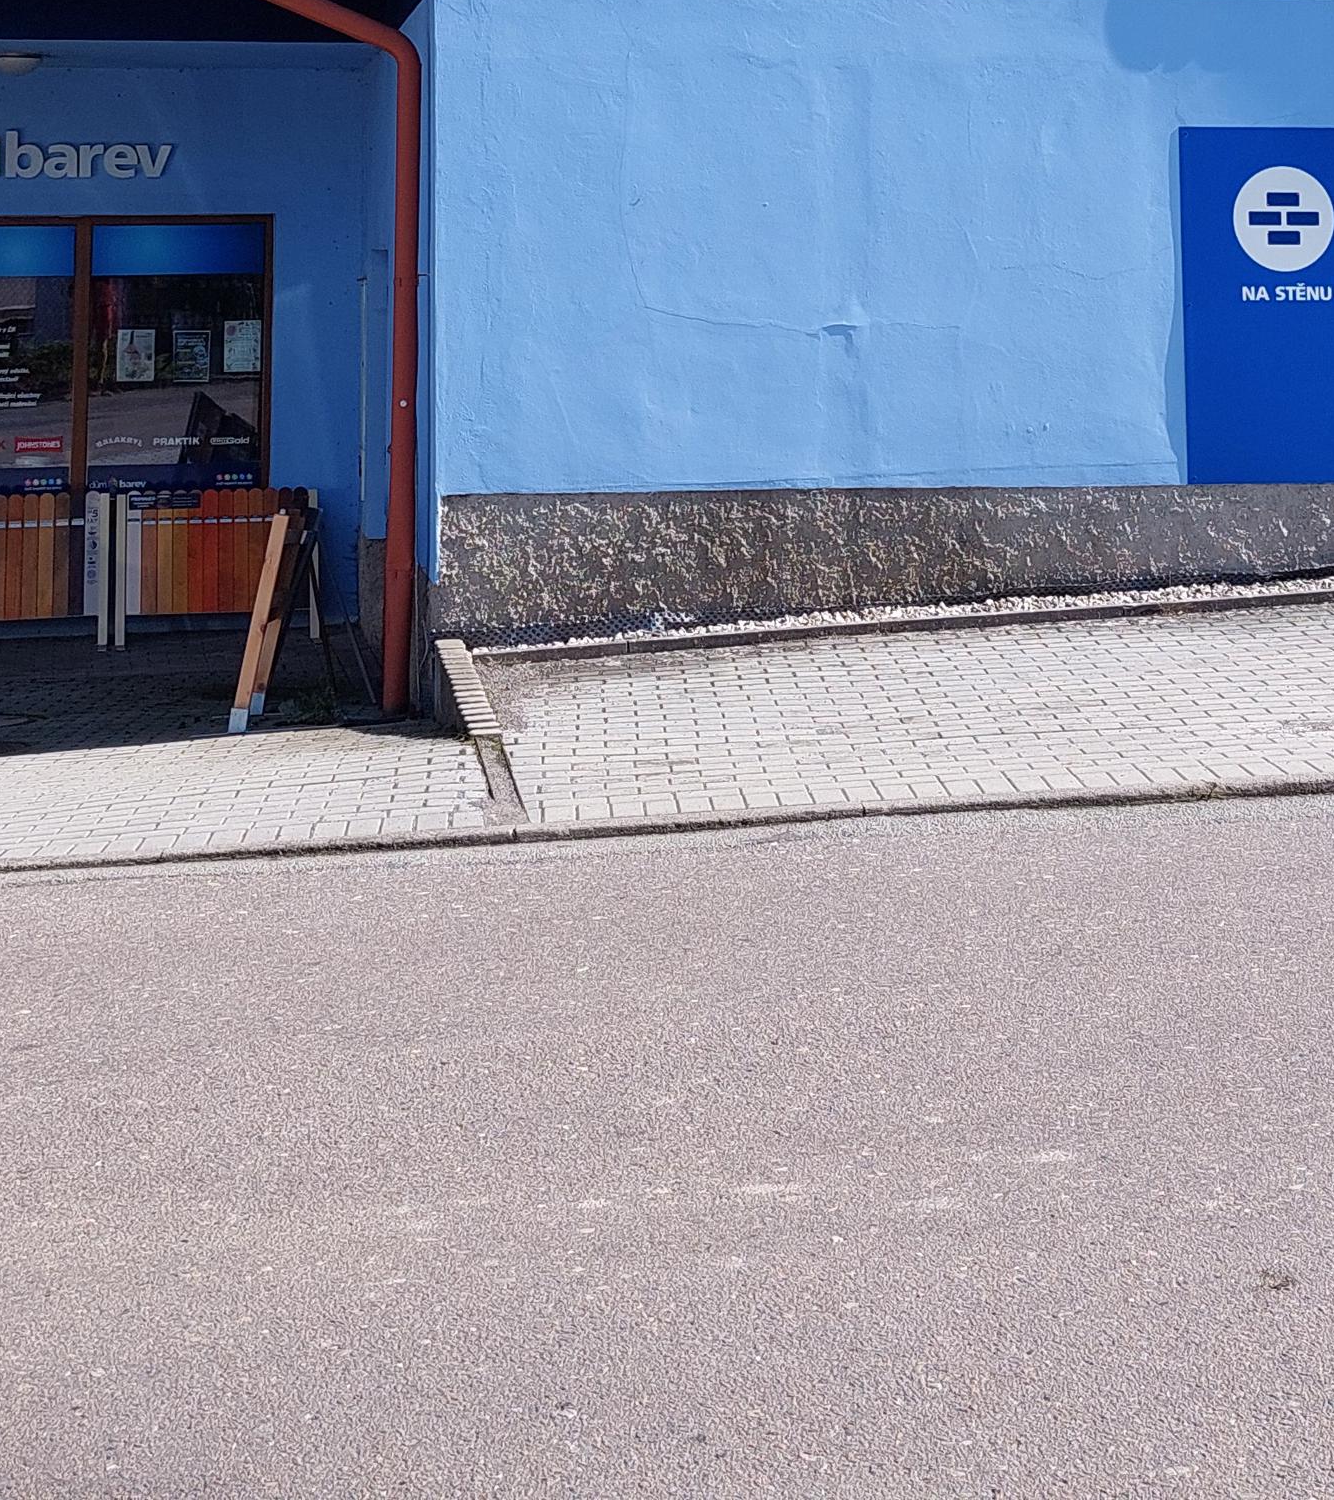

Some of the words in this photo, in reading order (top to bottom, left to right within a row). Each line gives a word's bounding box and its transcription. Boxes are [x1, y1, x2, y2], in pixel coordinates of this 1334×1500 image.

[6, 131, 173, 180] barev
[1242, 286, 1270, 301] NA
[1275, 282, 1332, 301] STĚNU
[152, 436, 200, 446] PRAKTIK
[119, 480, 147, 489] barev
